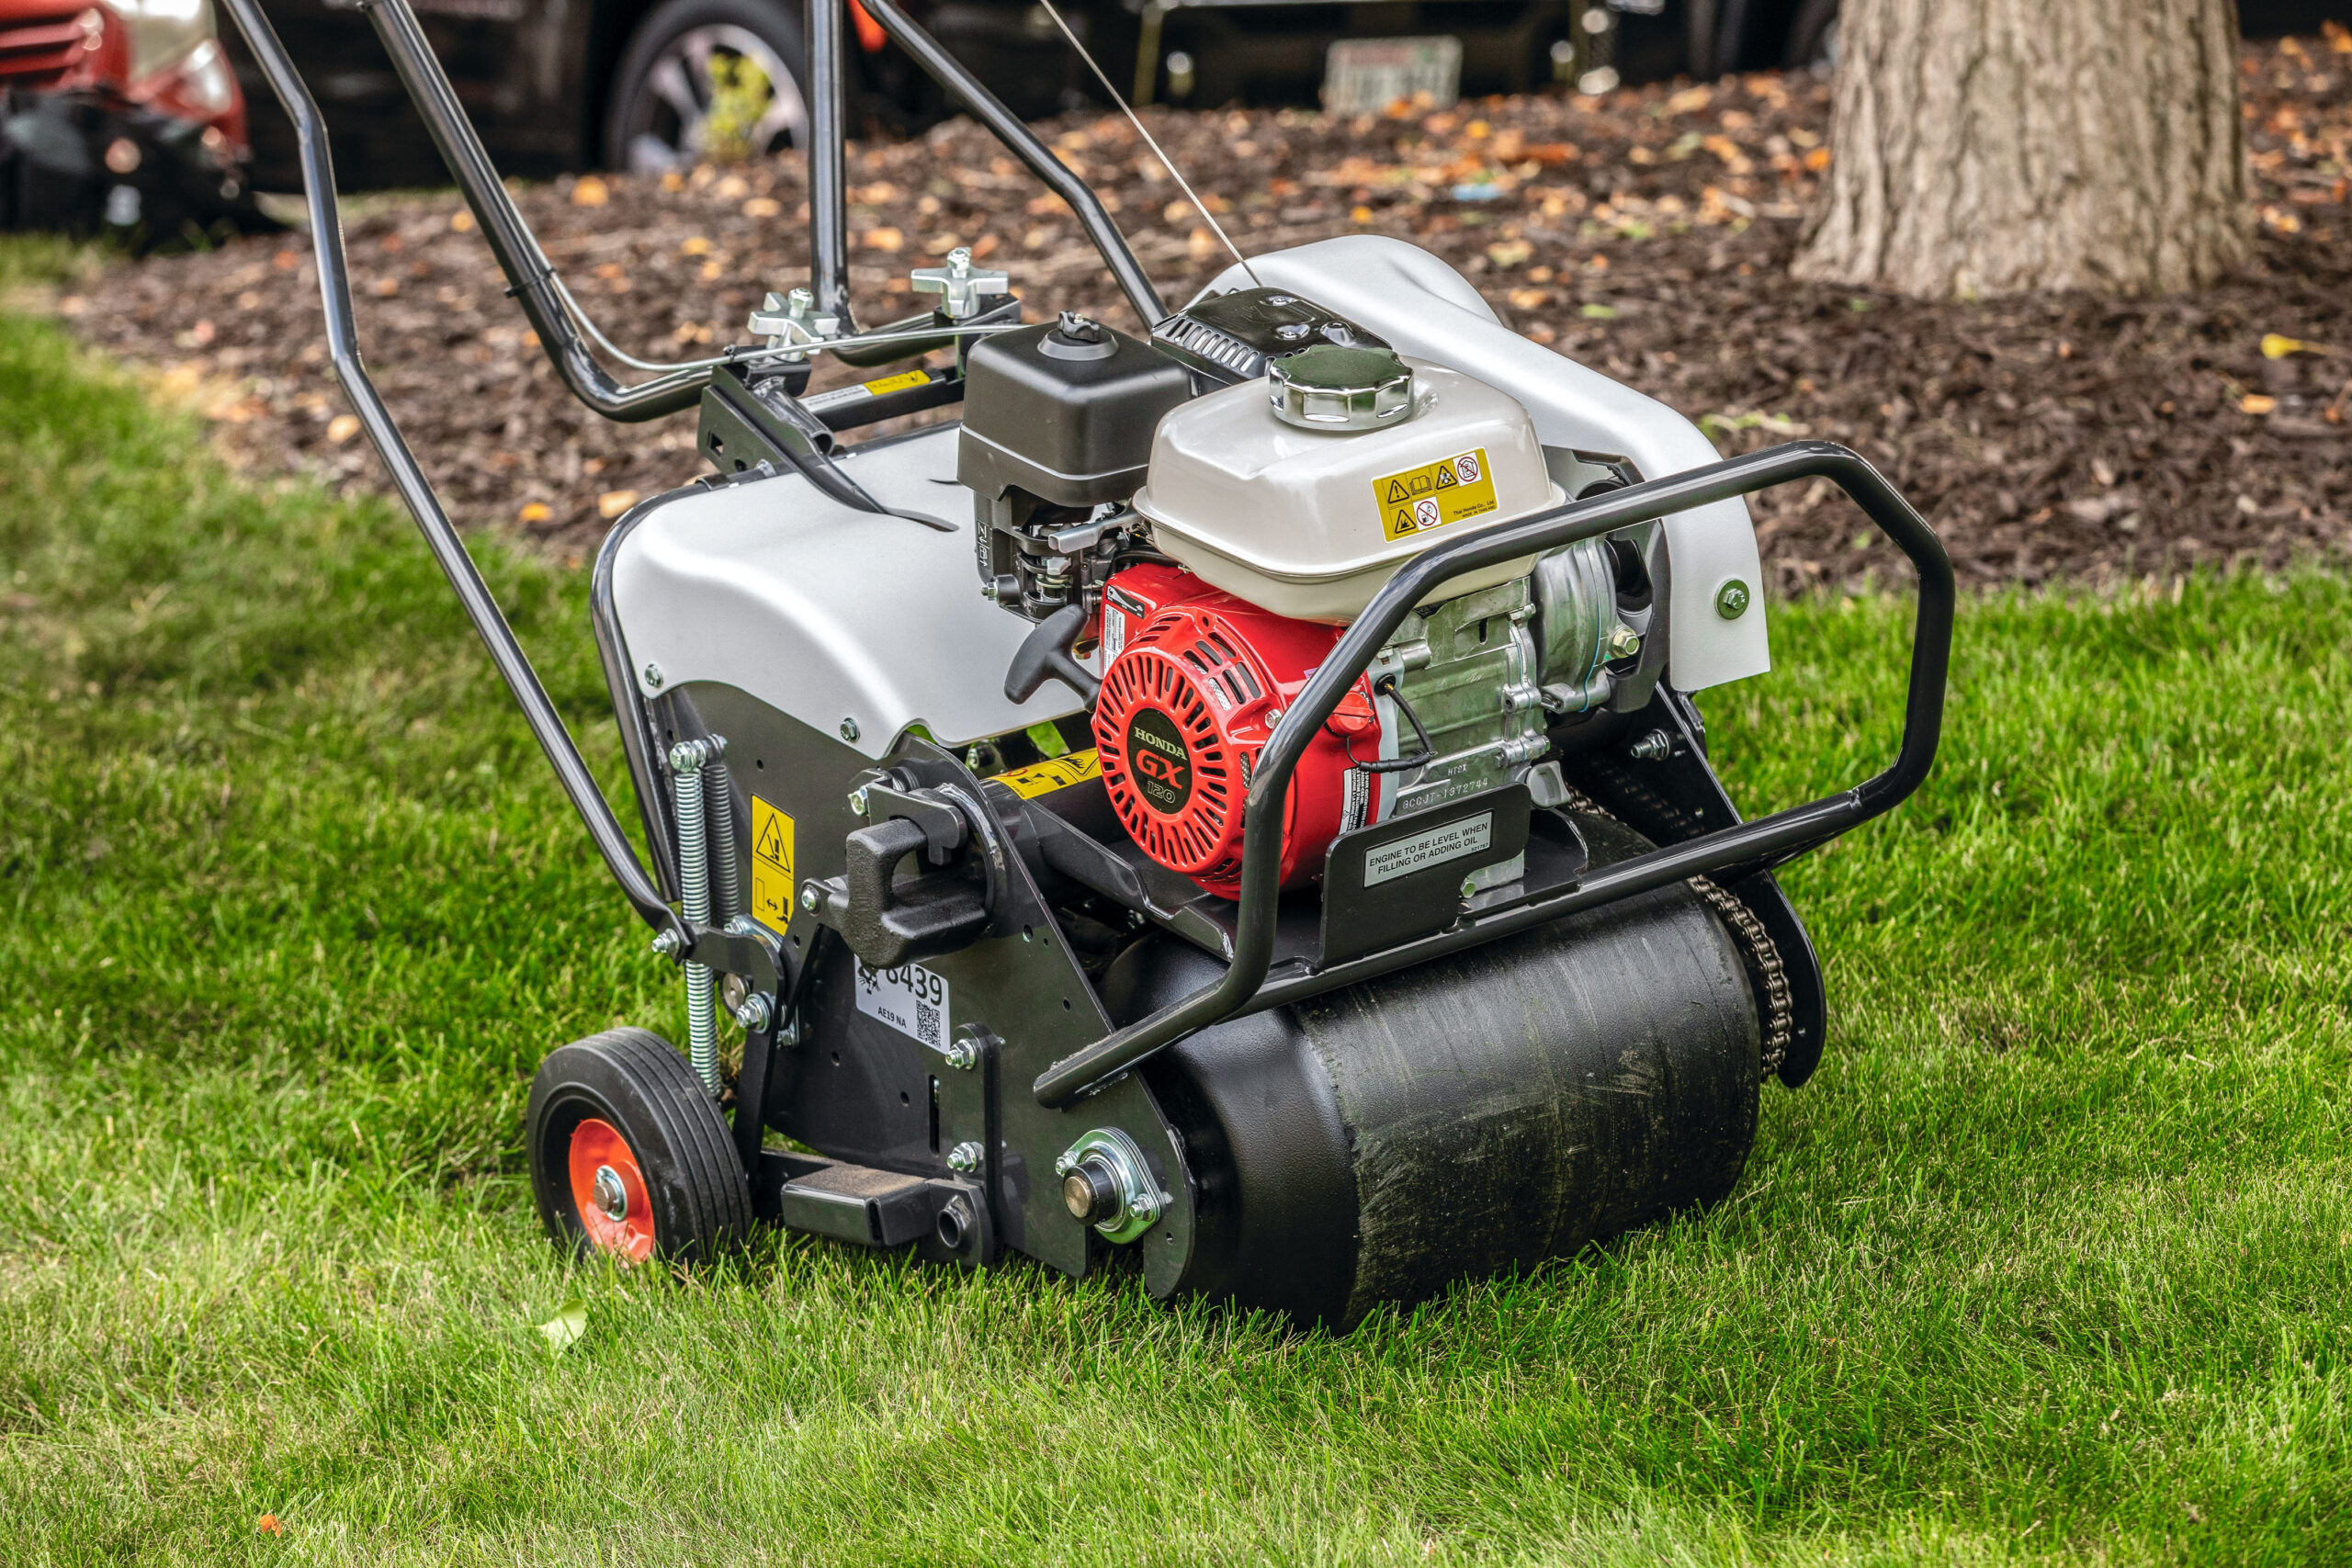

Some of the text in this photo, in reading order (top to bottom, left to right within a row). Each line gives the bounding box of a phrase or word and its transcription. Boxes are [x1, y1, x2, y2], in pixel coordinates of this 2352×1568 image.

[1134, 727, 1187, 761] HONDA
[1136, 749, 1185, 790] GX
[1147, 780, 1176, 804] 120
[1369, 822, 1488, 866] ENGINE TO BE LEVEL WHEN
[1378, 836, 1478, 874] FILLING OR ADDING OIL
[877, 1006, 907, 1029] AE19 NA
